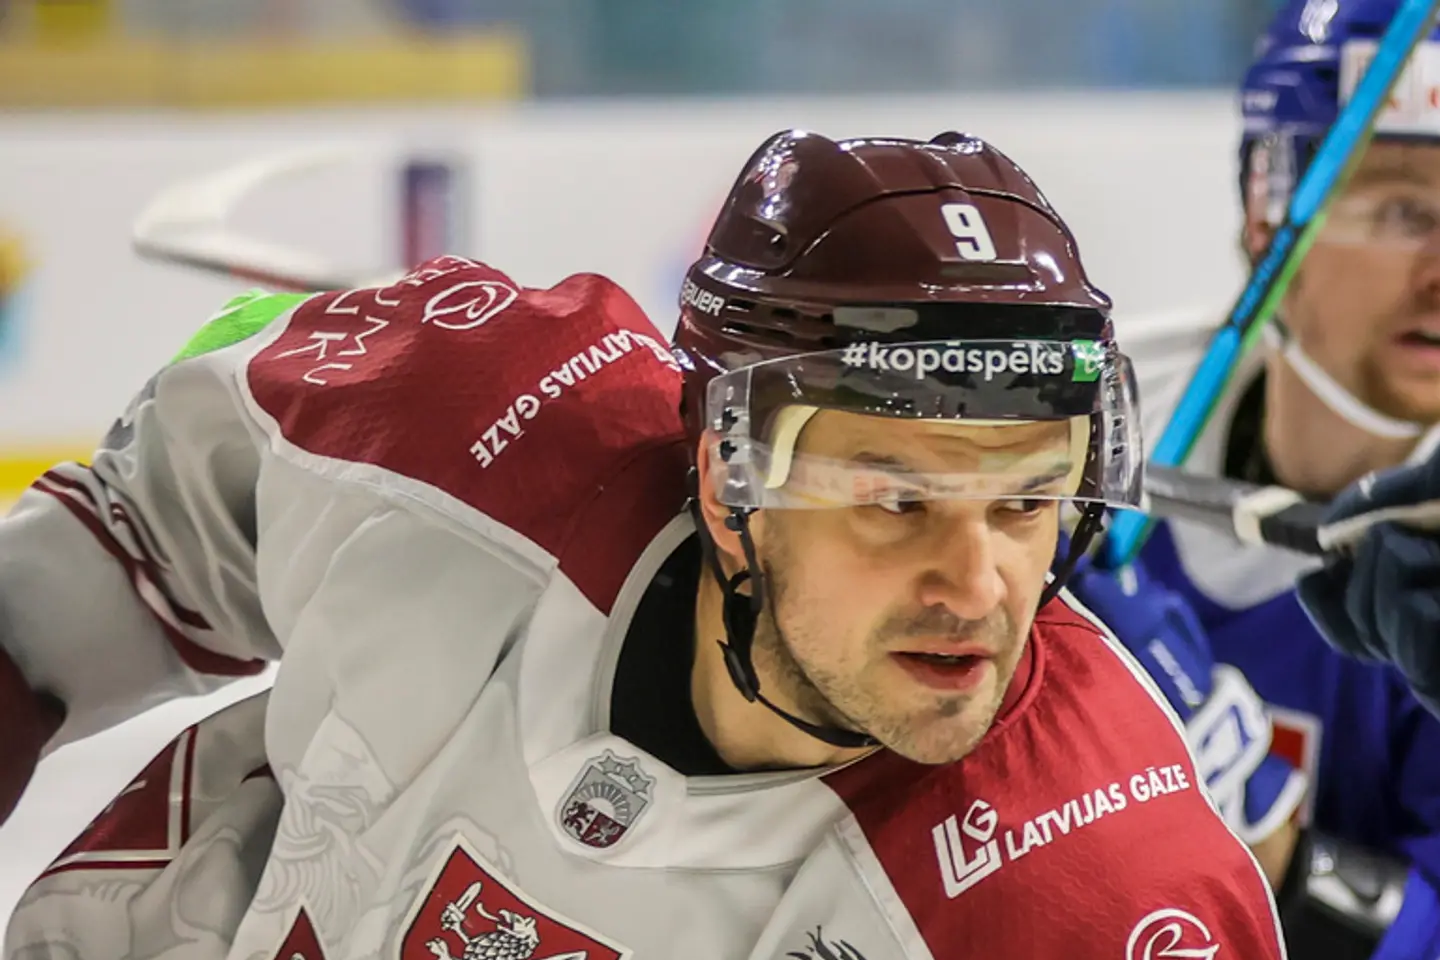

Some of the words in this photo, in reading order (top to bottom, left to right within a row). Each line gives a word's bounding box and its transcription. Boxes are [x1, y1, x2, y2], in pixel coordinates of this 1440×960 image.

[940, 203, 997, 261] 9
[841, 341, 1064, 381] #kopāspēks
[468, 393, 542, 469] GĀZE
[1004, 782, 1128, 861] LATVIJAS
[1129, 763, 1191, 804] GĀZE
